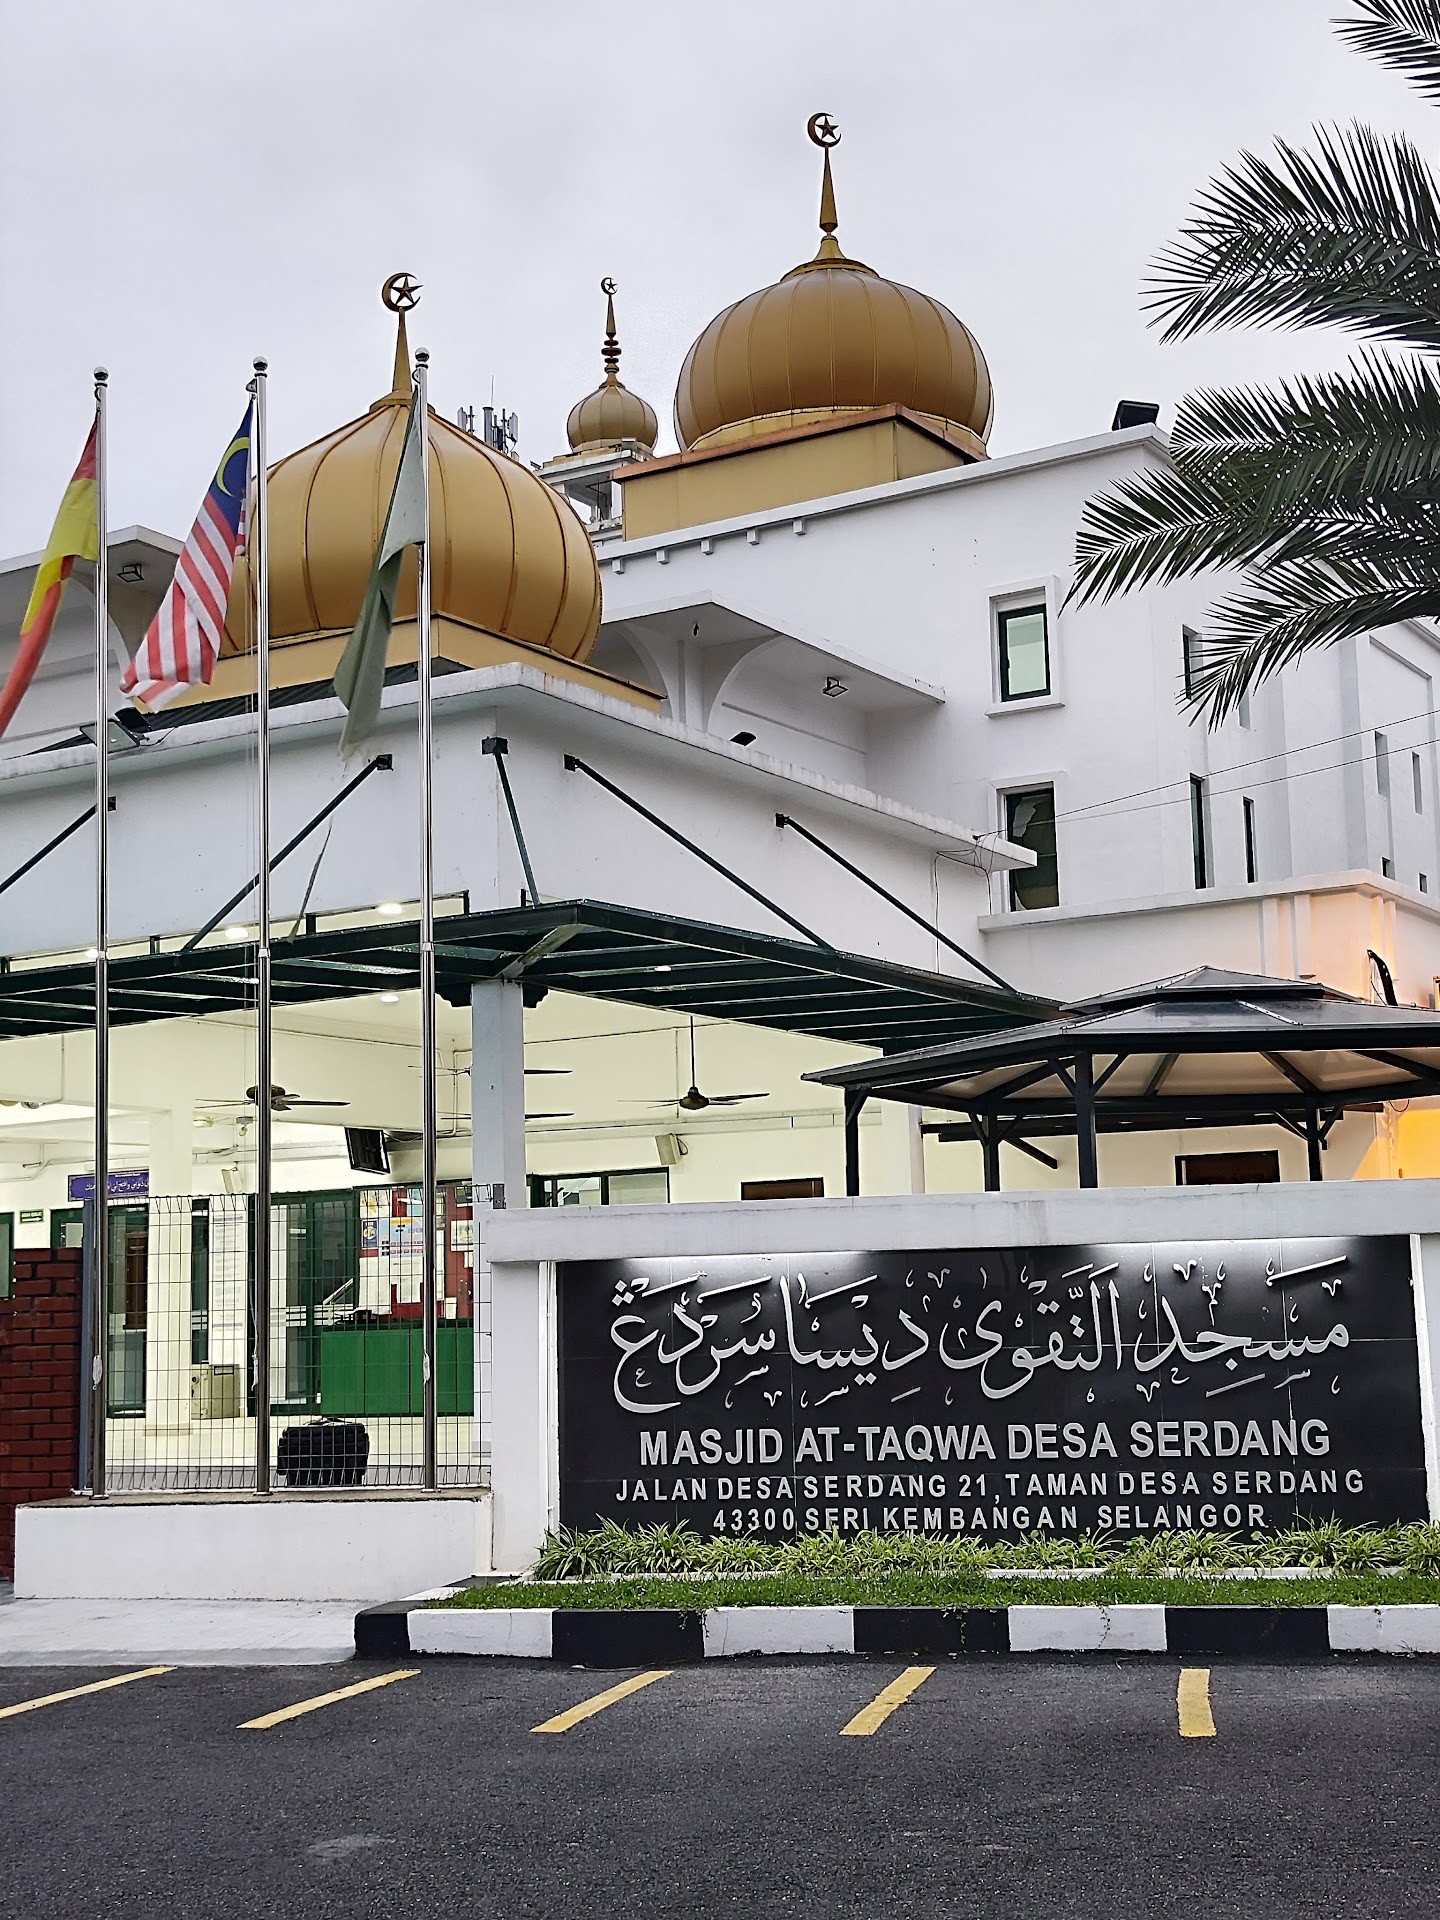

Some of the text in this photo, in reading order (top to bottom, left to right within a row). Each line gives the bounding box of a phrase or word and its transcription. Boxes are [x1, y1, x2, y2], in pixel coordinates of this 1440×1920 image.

[640, 1419, 1330, 1466] MASJID AT-TAQWA DESA SERDANG
[615, 1478, 707, 1502] JALAN
[718, 1477, 793, 1500] DESA
[803, 1475, 946, 1499] SERDANG
[1118, 1472, 1200, 1495] DESA
[1212, 1470, 1364, 1495] SERDANG
[713, 1508, 796, 1532] 43300
[804, 1507, 870, 1531] SERI
[1097, 1504, 1265, 1529] SELANGOR
